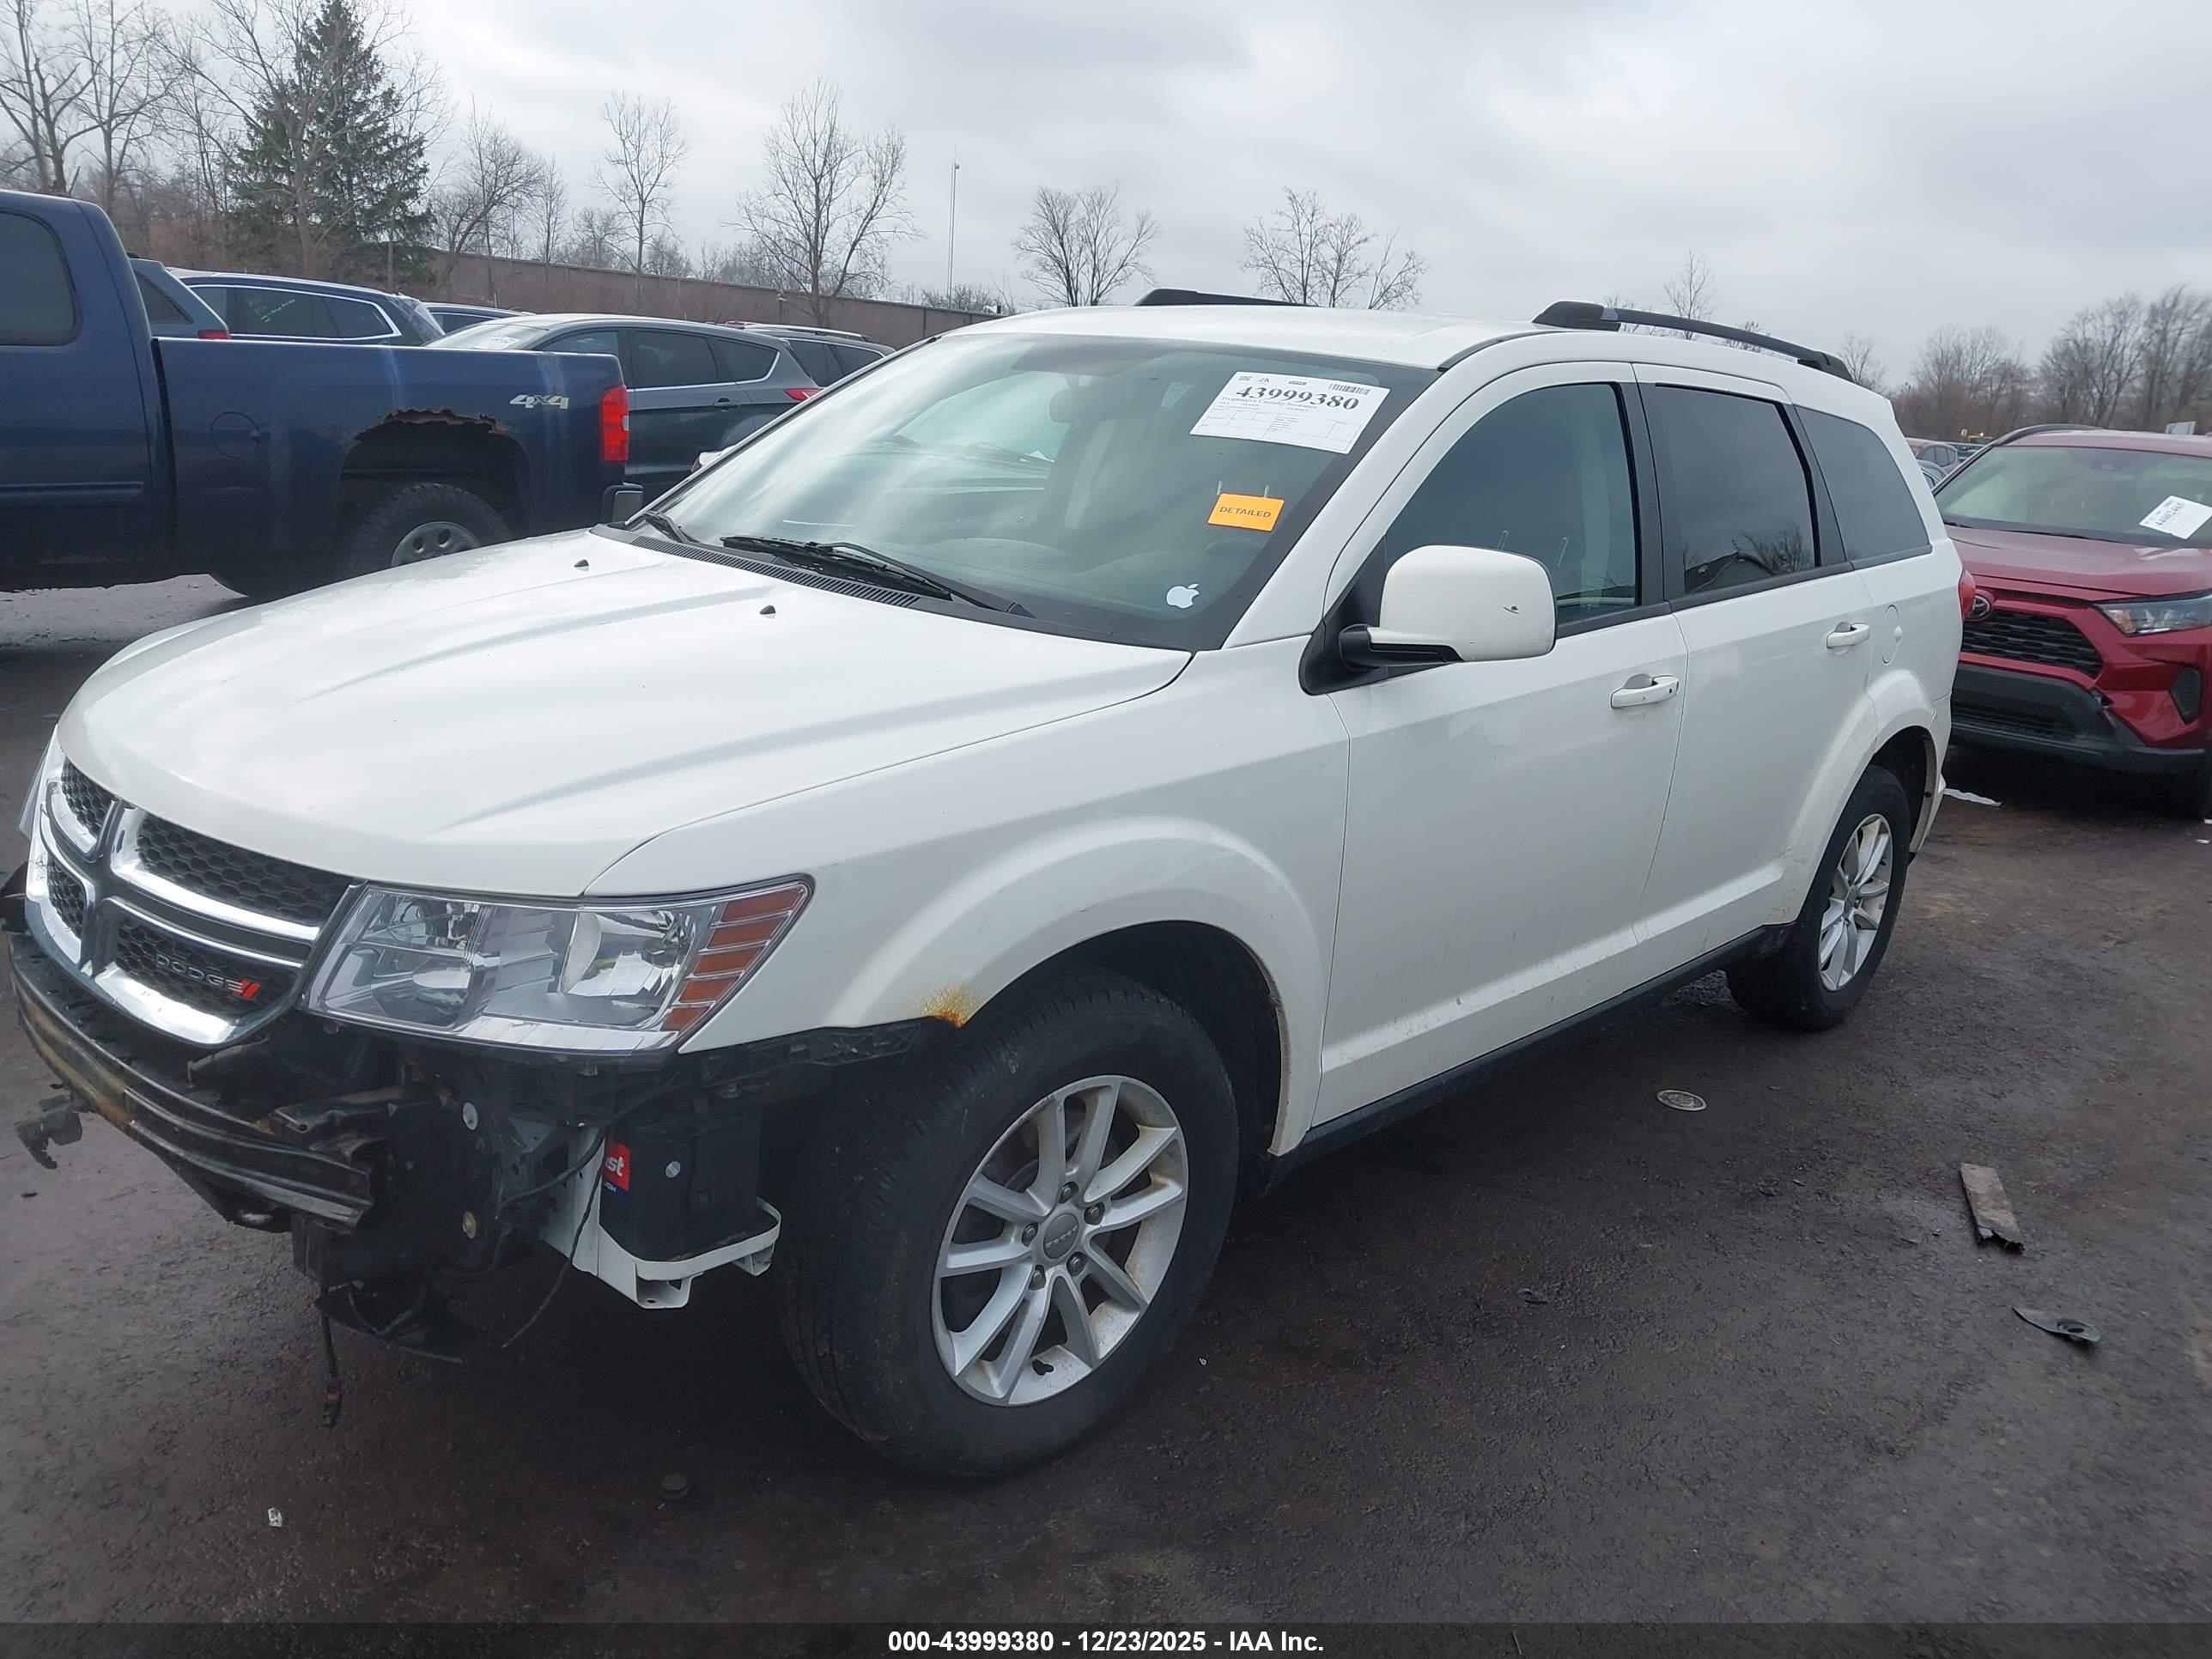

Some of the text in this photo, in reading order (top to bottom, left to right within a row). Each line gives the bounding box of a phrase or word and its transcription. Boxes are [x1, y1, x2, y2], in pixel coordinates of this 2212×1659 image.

[1236, 386, 1359, 410] 43999380
[1219, 506, 1272, 519] DETAILED
[155, 954, 244, 994] DODGE
